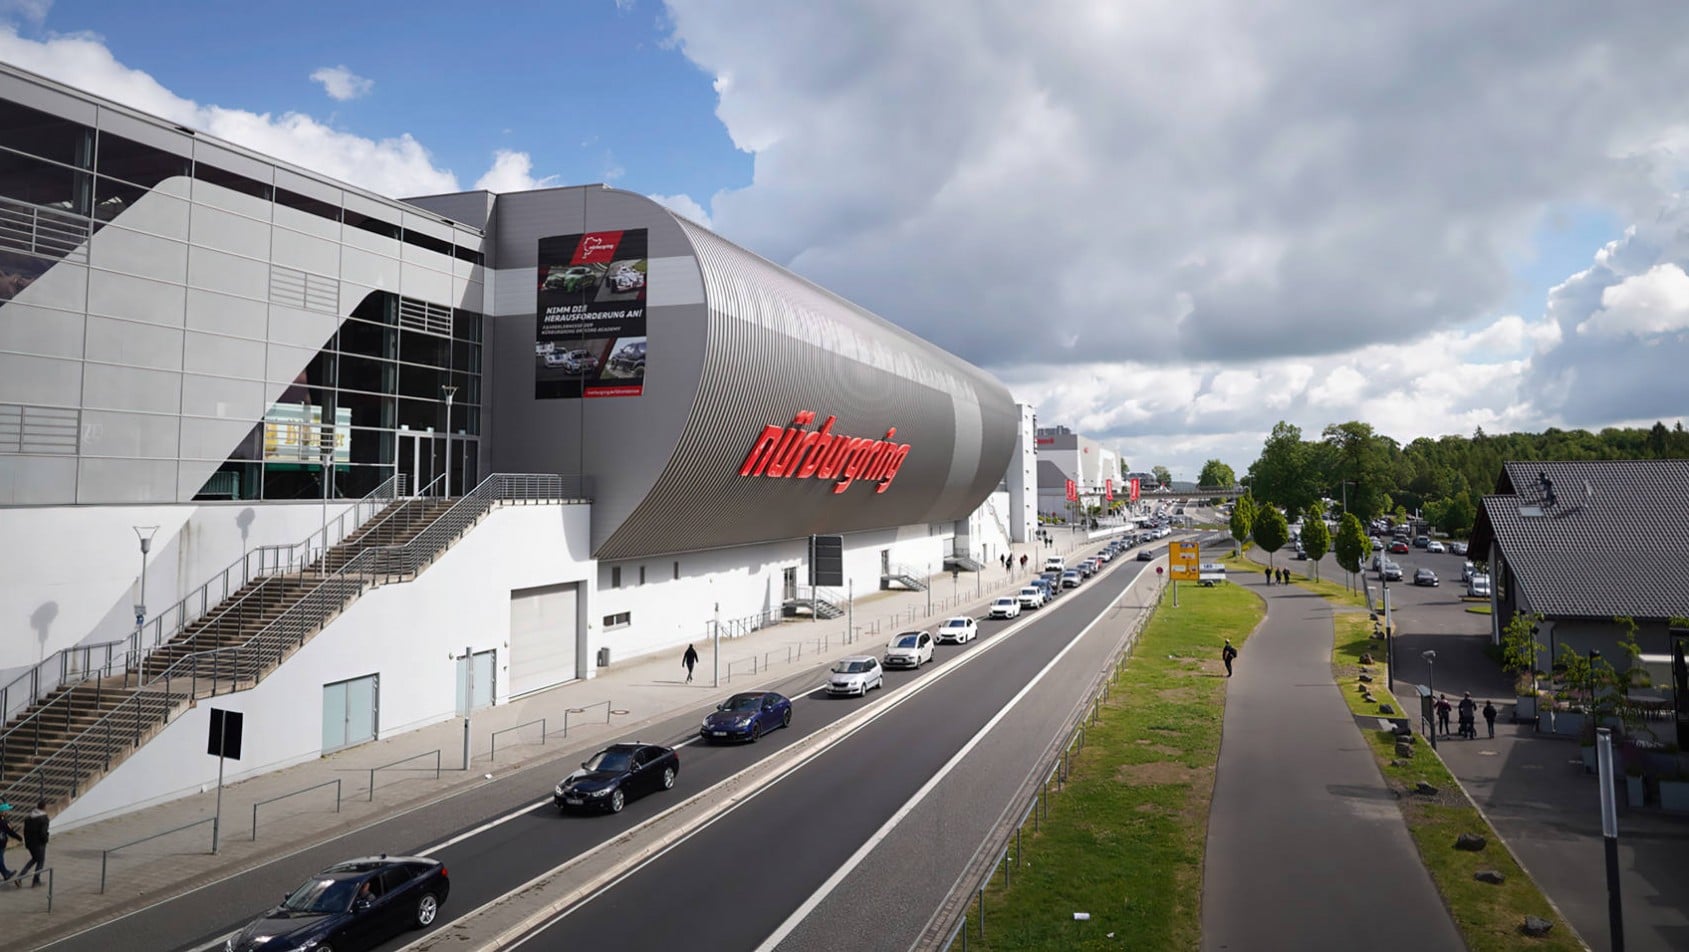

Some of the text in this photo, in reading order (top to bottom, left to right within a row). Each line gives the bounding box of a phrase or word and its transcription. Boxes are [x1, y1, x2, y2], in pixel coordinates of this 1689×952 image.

[544, 309, 642, 322] HERAUSFORDERUNG AN!
[546, 305, 587, 314] NIMM DIE
[738, 410, 911, 494] nürburgring
